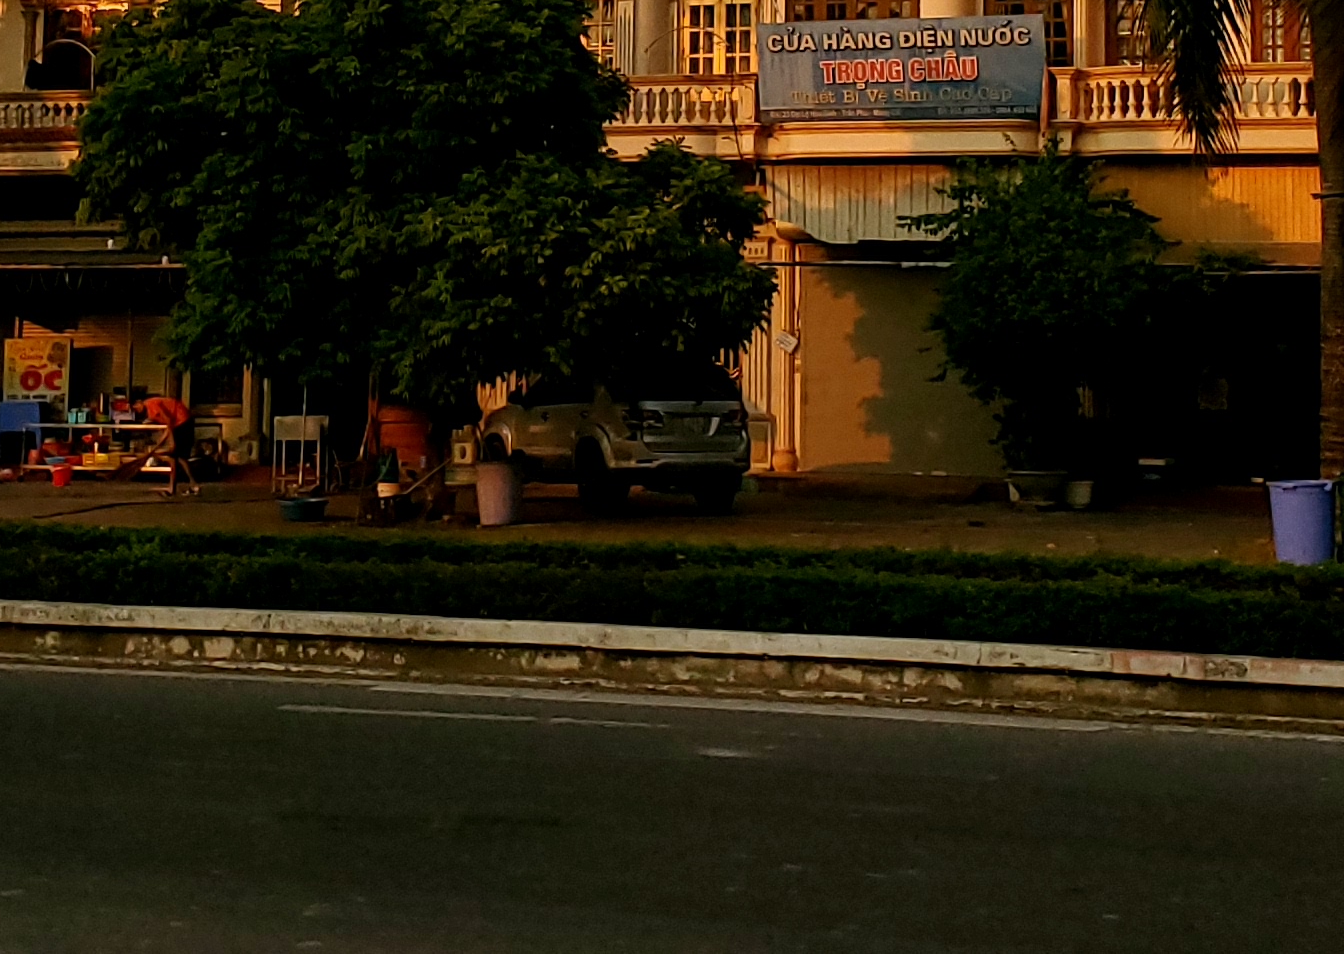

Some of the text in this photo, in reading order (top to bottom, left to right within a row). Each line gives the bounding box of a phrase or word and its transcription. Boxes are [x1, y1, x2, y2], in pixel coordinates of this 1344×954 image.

[767, 20, 1031, 53] CỬA HÀNG ĐIỆN NƯỚC
[820, 50, 980, 89] TRỌNG CHÂU
